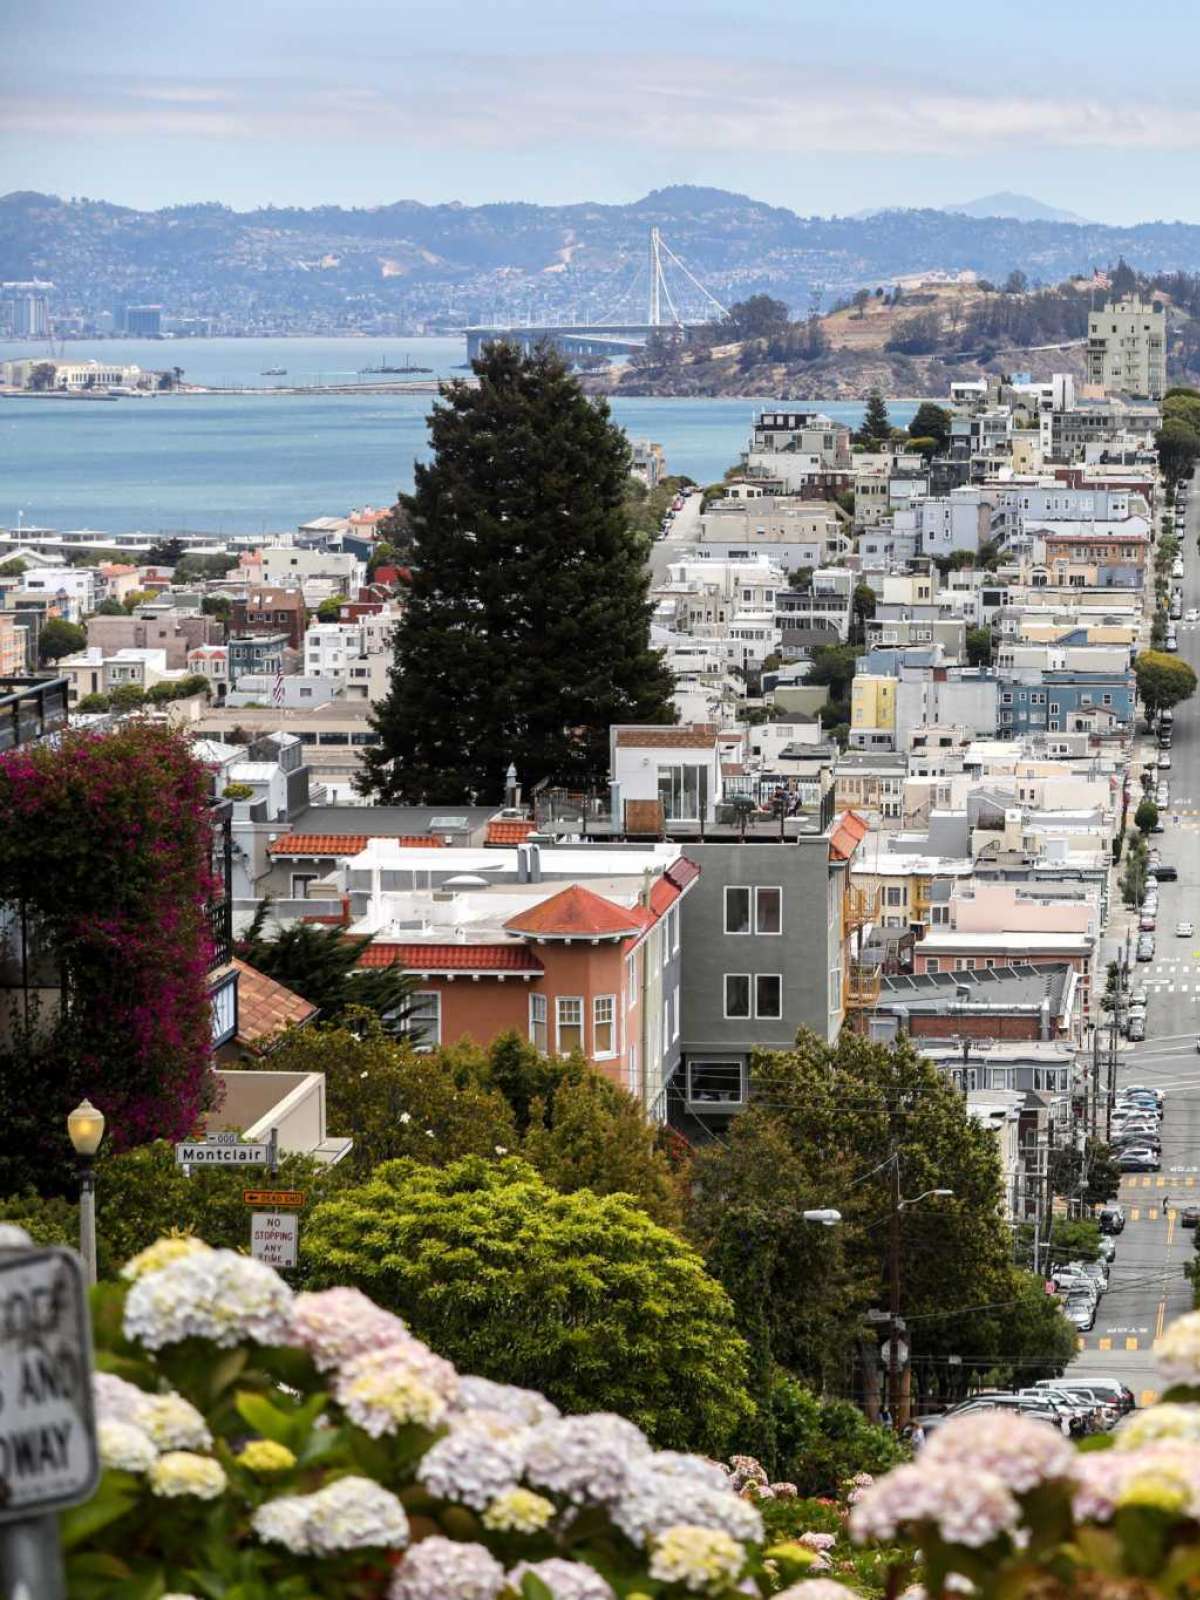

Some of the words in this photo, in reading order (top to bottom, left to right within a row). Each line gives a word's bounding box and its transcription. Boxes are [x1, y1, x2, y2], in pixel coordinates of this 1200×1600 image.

[183, 1149, 261, 1161] Montclair
[261, 1194, 282, 1202] DEAD
[285, 1194, 300, 1202] END
[266, 1218, 281, 1227] NO
[255, 1231, 293, 1241] STOPPING
[264, 1244, 282, 1252] ANY
[263, 1254, 283, 1263] TIME
[20, 1349, 77, 1407] AND
